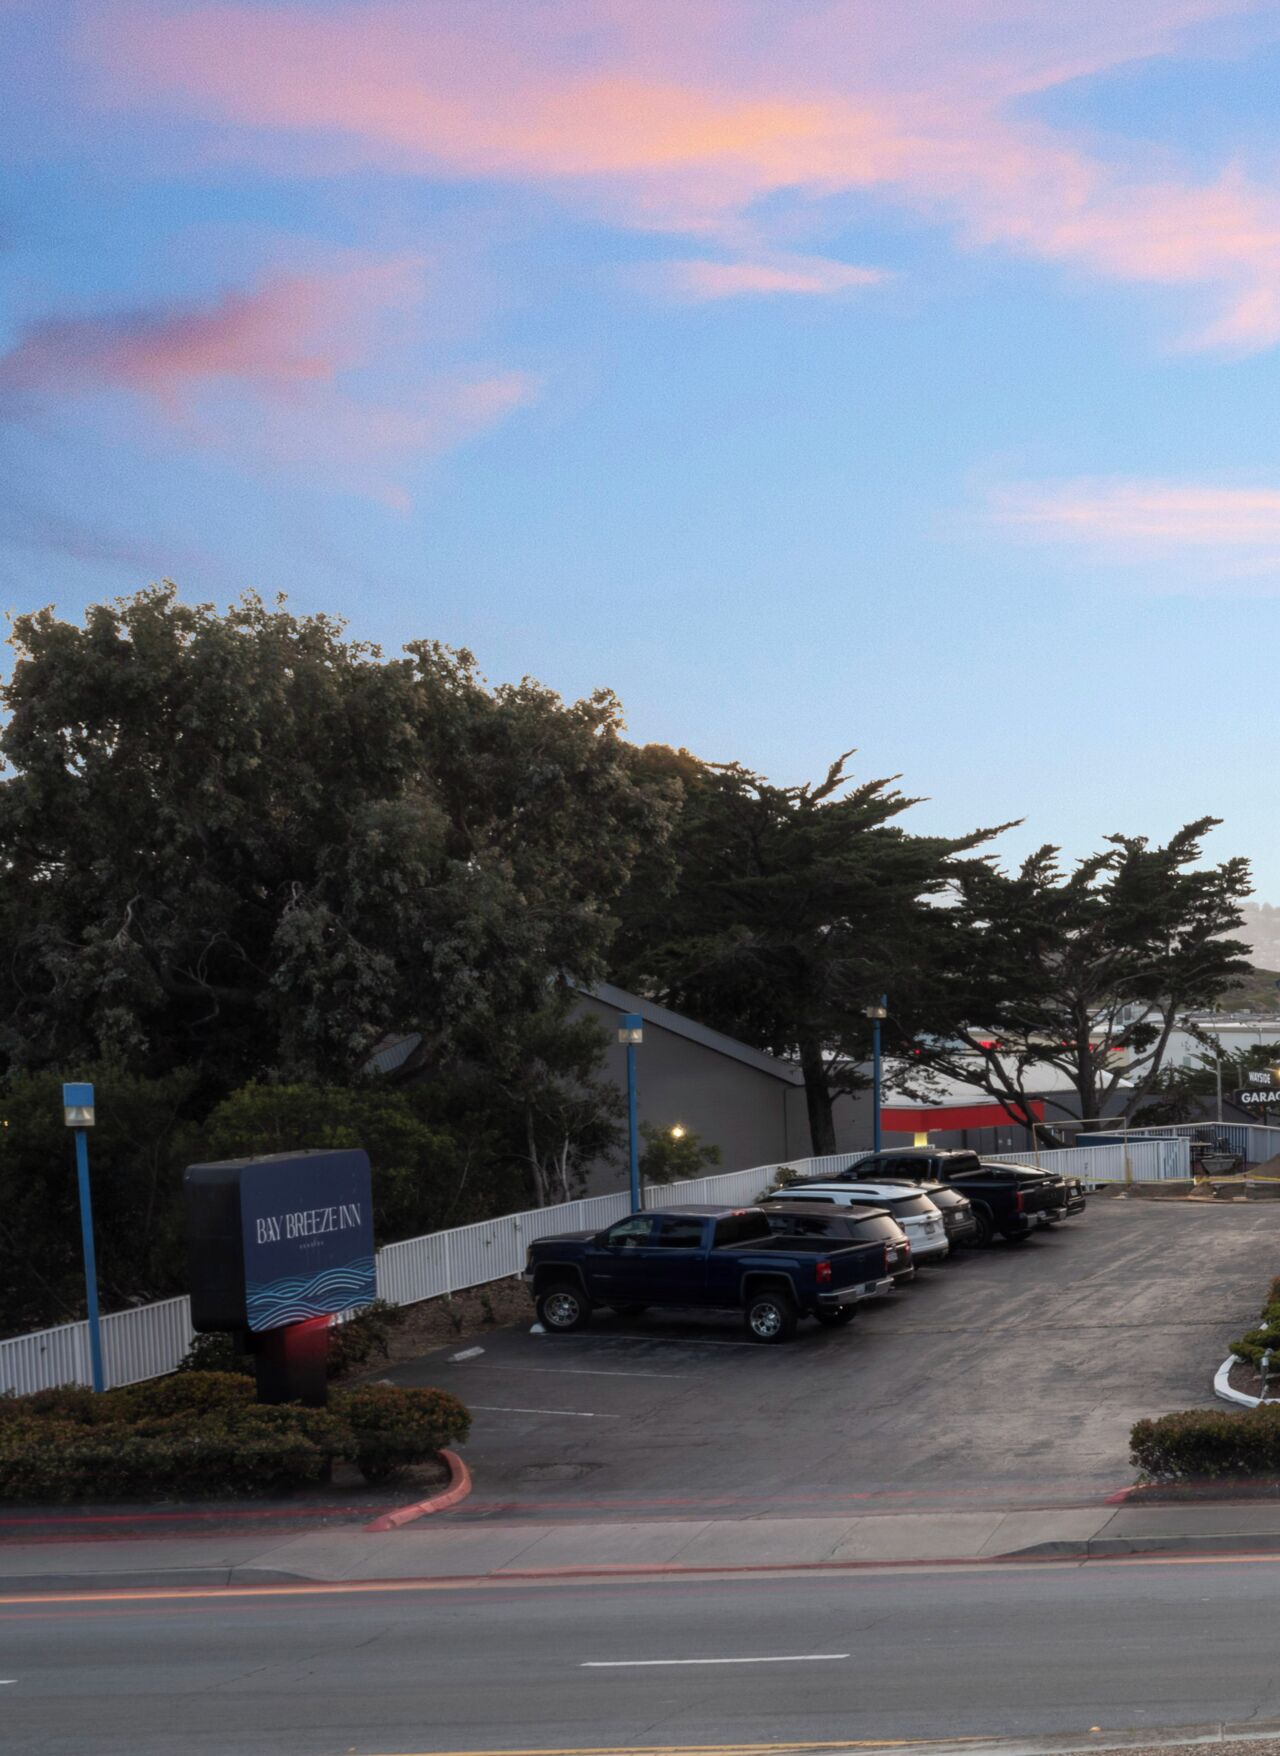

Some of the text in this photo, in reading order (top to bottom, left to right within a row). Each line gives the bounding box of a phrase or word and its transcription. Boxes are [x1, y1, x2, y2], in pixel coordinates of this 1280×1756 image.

[256, 1203, 361, 1244] BAY BREEZE INN
